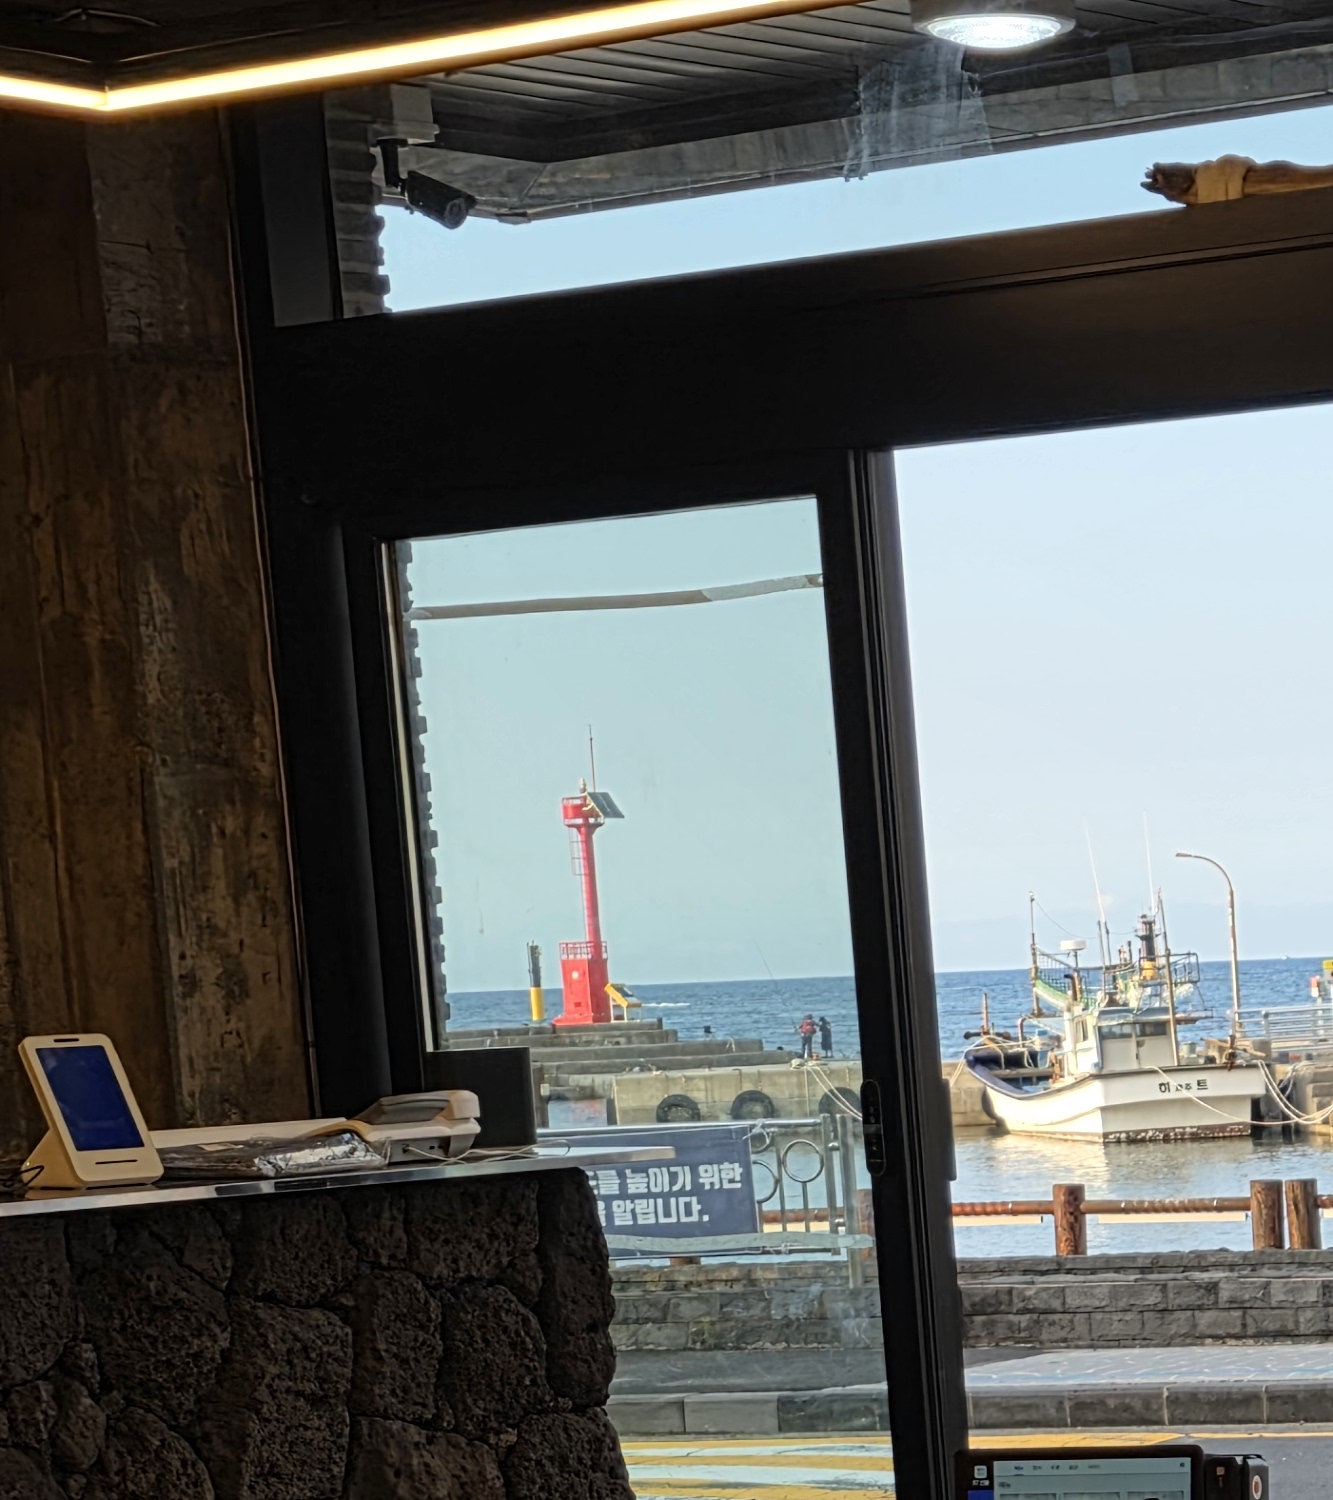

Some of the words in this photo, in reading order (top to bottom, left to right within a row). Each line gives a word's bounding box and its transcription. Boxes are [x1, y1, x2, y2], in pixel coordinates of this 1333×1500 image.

[625, 1165, 692, 1194] 높이기
[698, 1161, 743, 1190] 위한
[612, 1196, 710, 1226] 알립니다.
